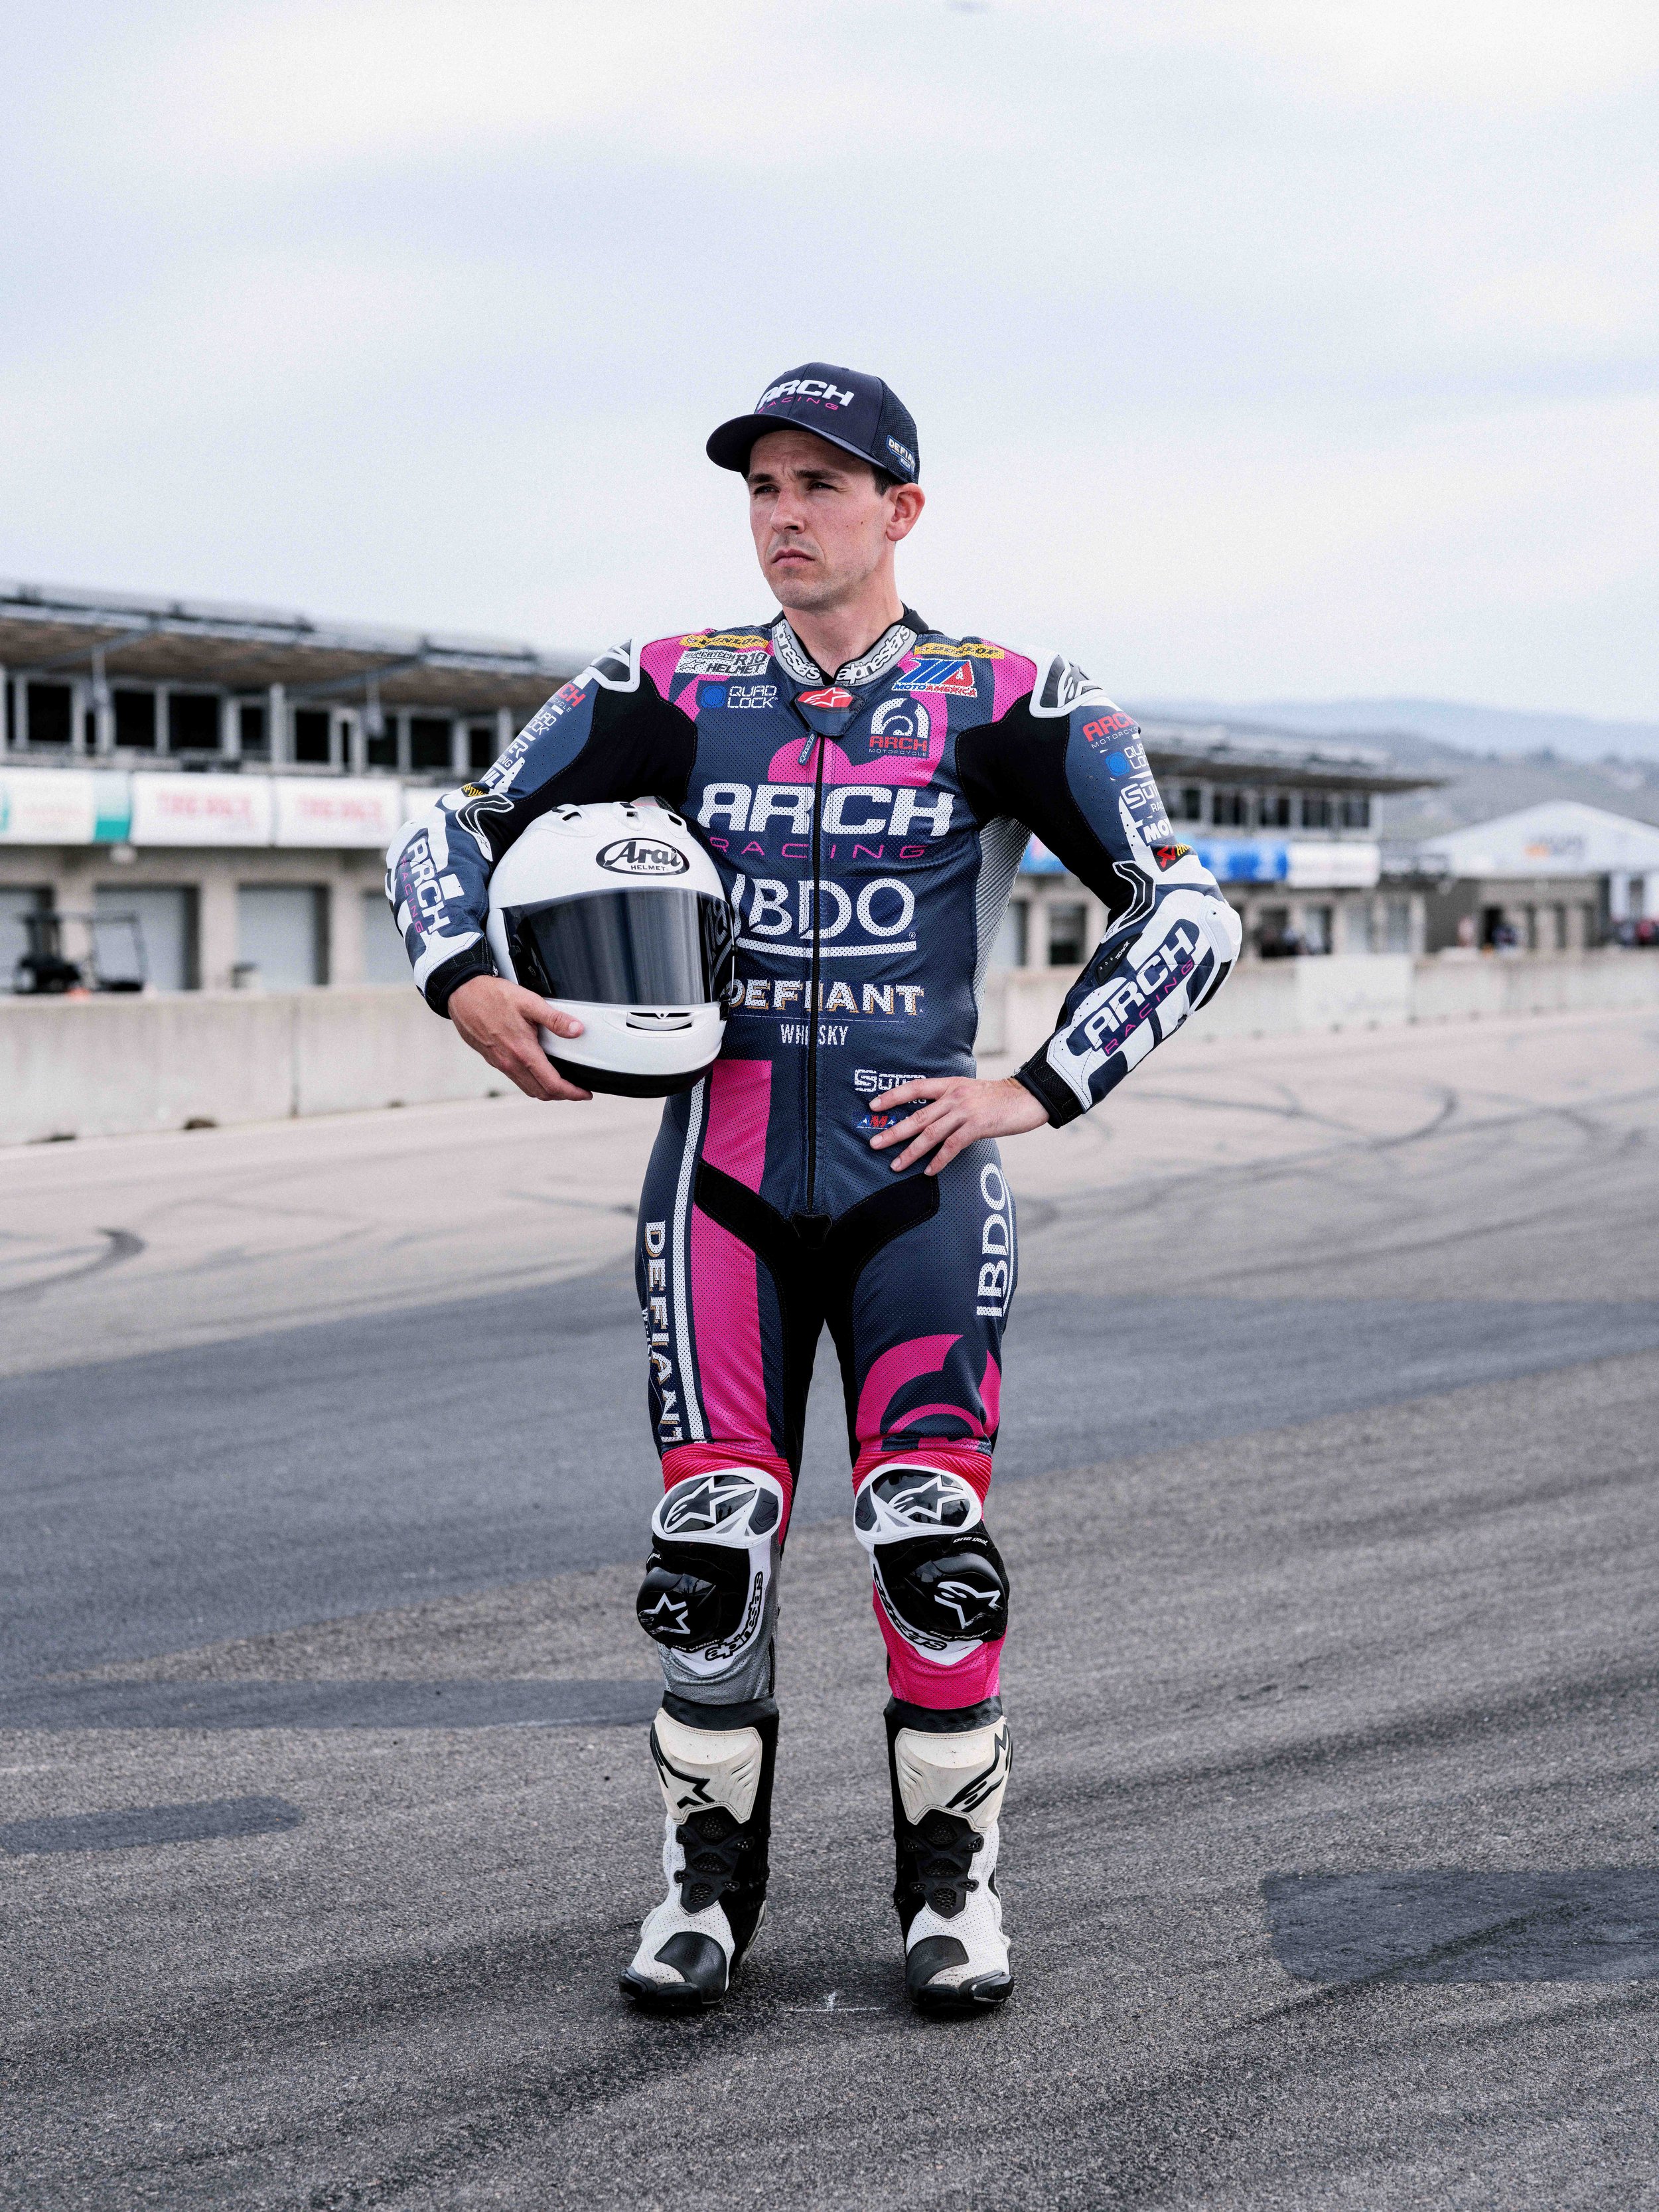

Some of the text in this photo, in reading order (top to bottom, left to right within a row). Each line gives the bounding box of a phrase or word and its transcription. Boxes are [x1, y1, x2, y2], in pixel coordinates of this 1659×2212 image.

[757, 379, 855, 410] ARCH
[684, 651, 768, 666] SUPERTECH R10
[705, 662, 764, 674] HELMET
[835, 625, 911, 685] alpinestars
[729, 685, 777, 697] QUAD
[869, 736, 928, 752] ARCH
[697, 782, 956, 838] ARCH
[604, 841, 681, 867] Arai
[709, 836, 929, 859] RACING
[401, 857, 424, 933] RACING
[407, 837, 451, 934] ARCH
[1083, 925, 1196, 1048] ARCH
[1104, 959, 1195, 1055] RACING
[705, 1572, 764, 1661] alpinestars
